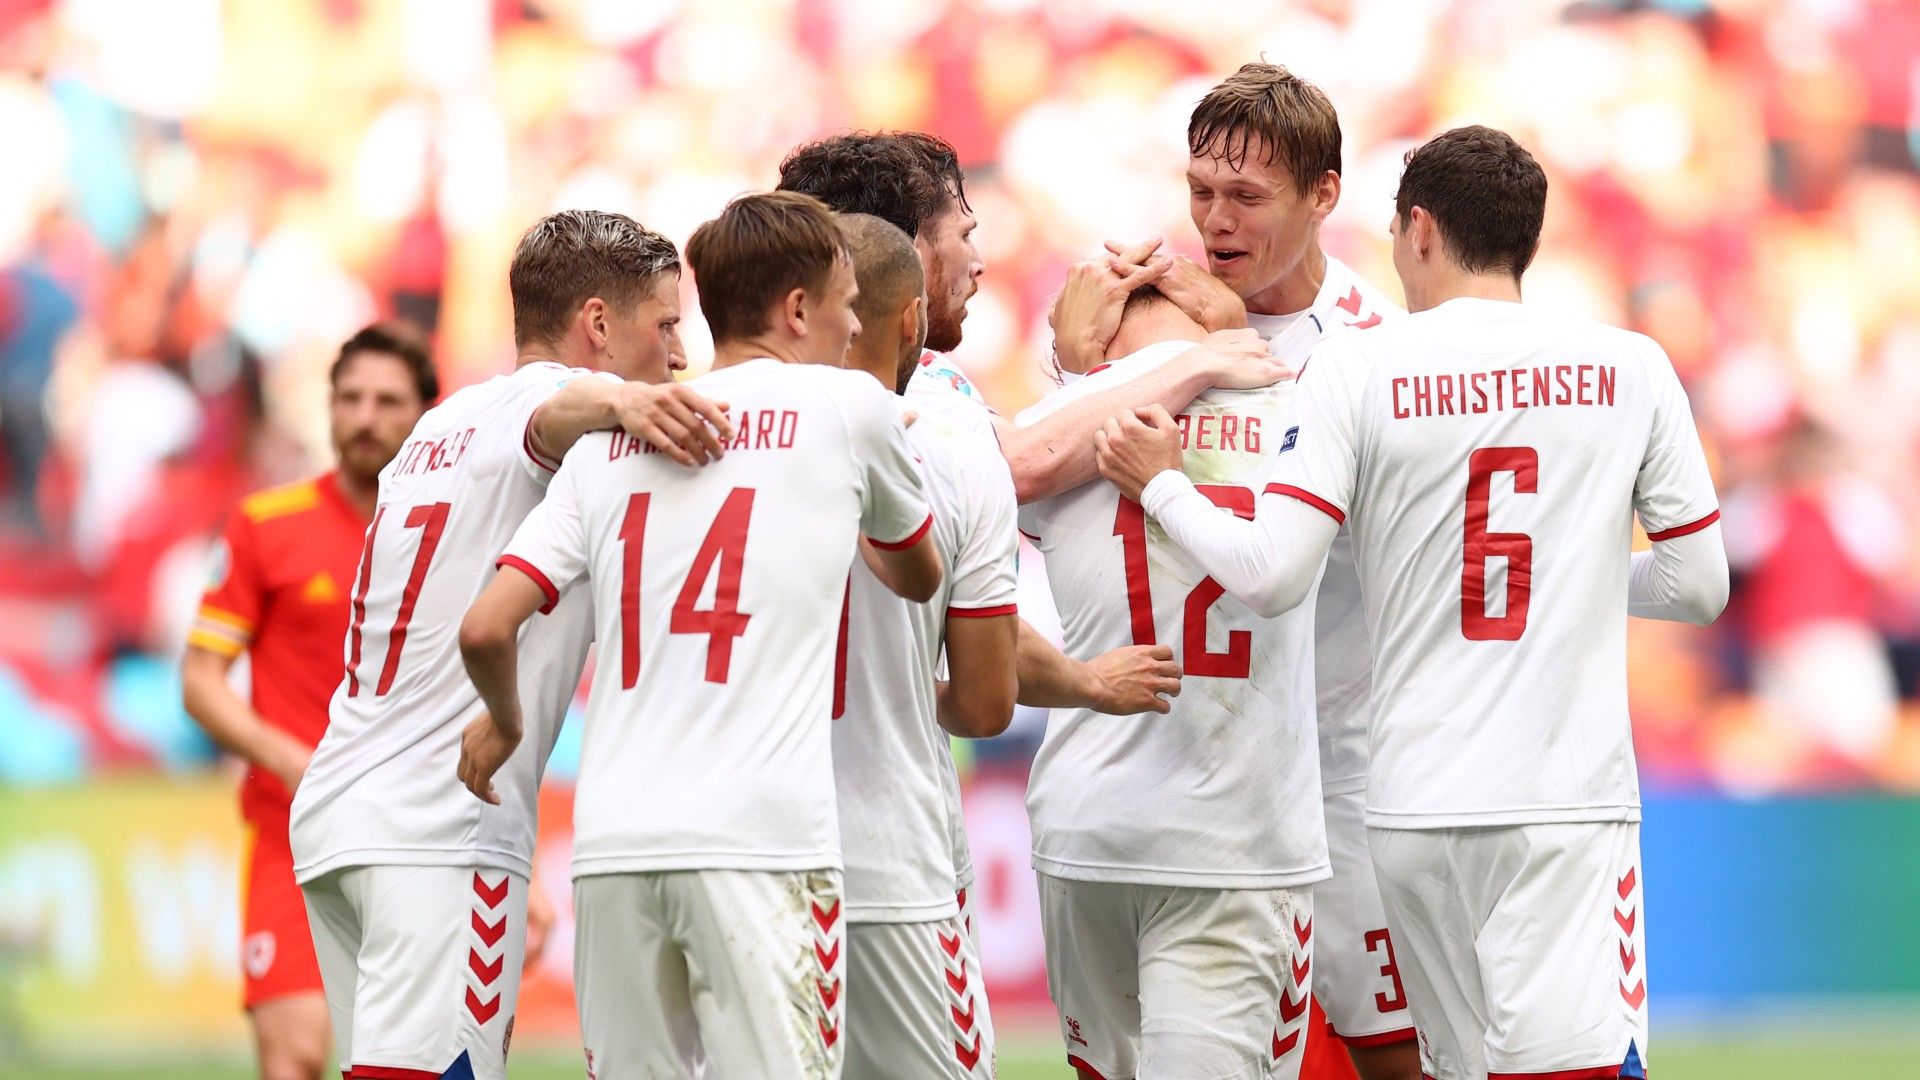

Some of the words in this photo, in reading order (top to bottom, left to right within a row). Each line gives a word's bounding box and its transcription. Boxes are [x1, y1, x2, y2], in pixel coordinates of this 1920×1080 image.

[1392, 364, 1616, 419] CHRISTENSEN
[347, 501, 451, 697] 17
[618, 486, 755, 691] 14
[1113, 484, 1256, 678] 12
[1461, 446, 1538, 641] 6
[1364, 928, 1408, 1013] 3
